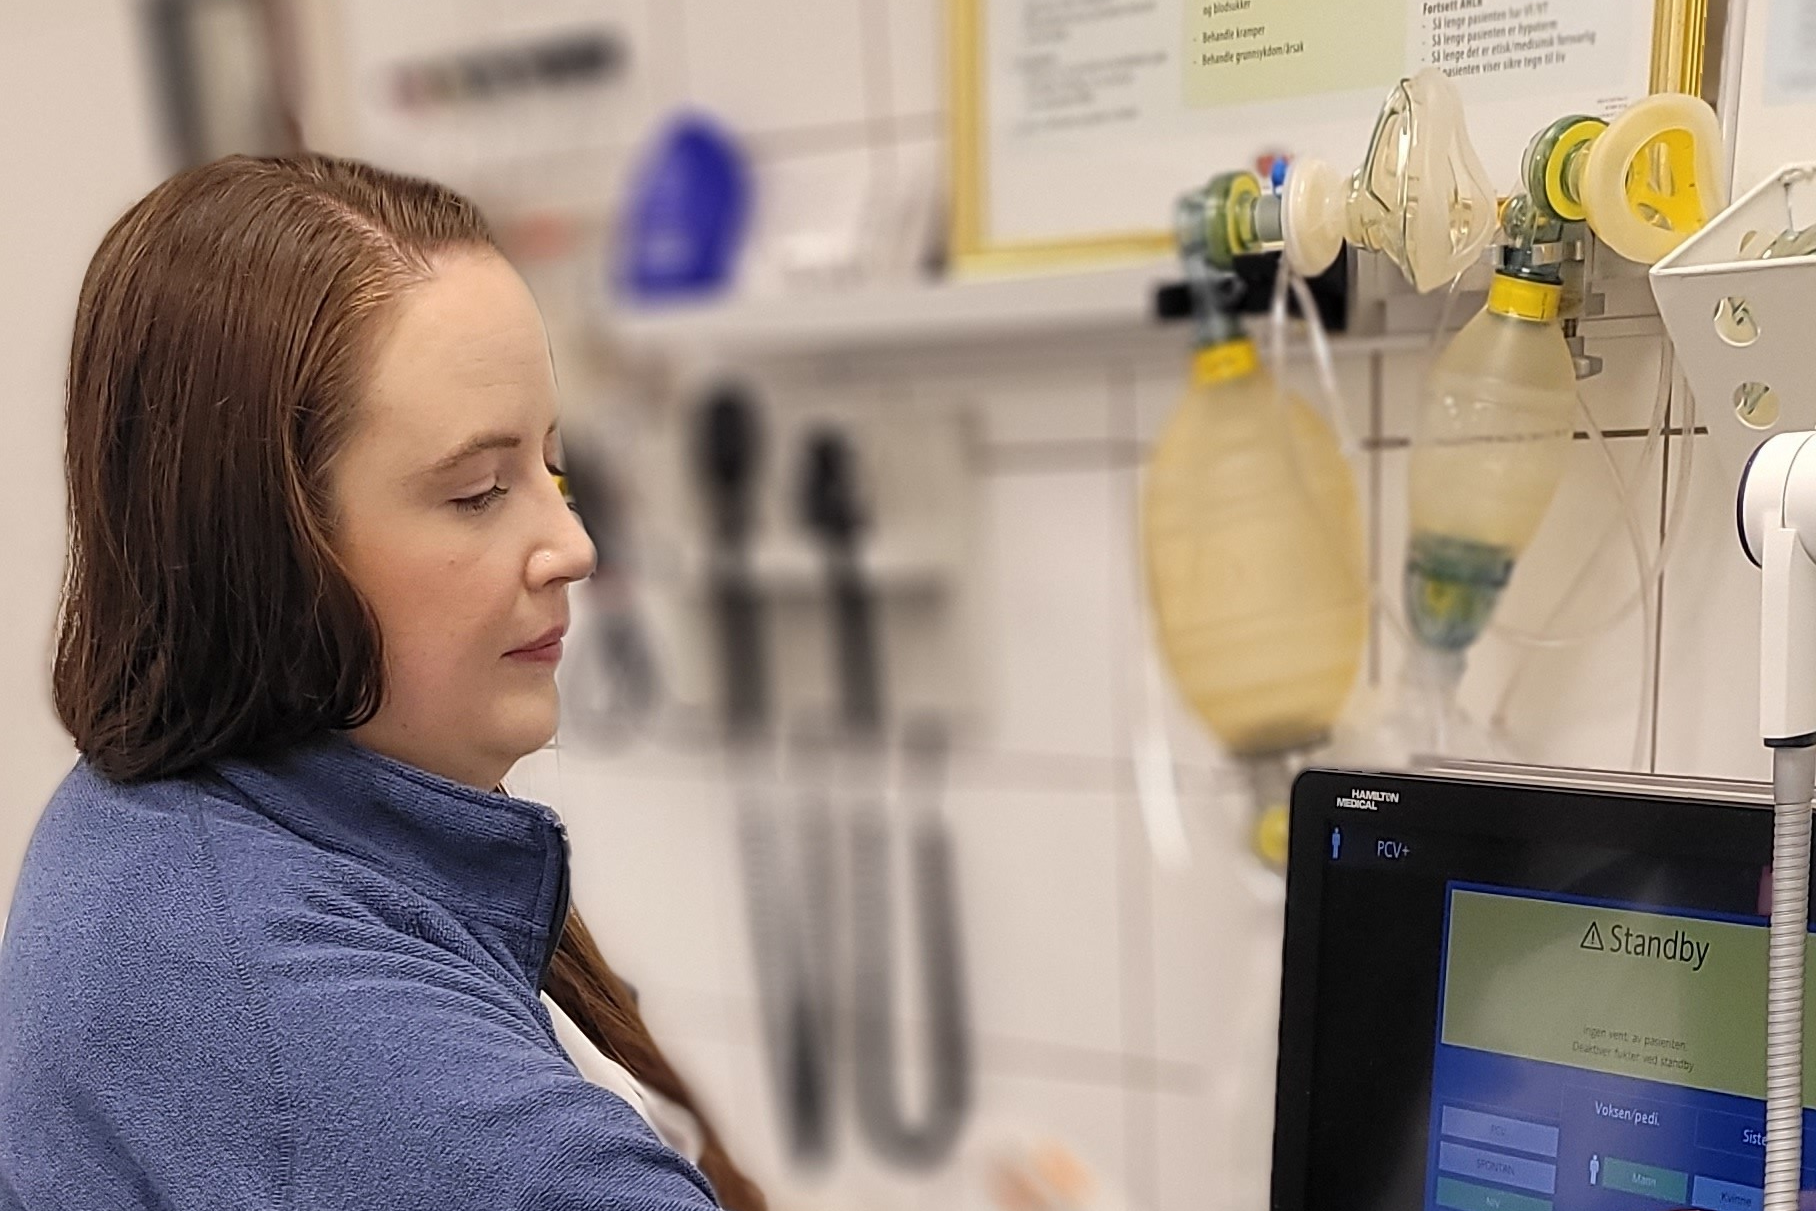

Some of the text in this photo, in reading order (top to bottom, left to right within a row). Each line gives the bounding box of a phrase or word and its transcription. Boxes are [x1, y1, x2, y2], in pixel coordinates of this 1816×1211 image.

[1423, 0, 1458, 16] Fortsett
[1432, 17, 1442, 31] Så
[1443, 15, 1466, 30] lenge
[1467, 10, 1507, 28] pasienten
[1202, 26, 1265, 44] Behandle kramper
[1432, 33, 1442, 48] Så
[1443, 32, 1466, 47] lenge
[1467, 26, 1507, 45] pasienten
[1507, 26, 1517, 37] er
[1202, 50, 1234, 66] Behandle
[1431, 50, 1441, 64] Så
[1443, 48, 1465, 64] lenge
[1466, 46, 1480, 59] det
[1481, 46, 1490, 57] er
[1483, 61, 1502, 74] viser
[1503, 57, 1522, 71] sikre
[1523, 54, 1543, 70] tegn
[1336, 797, 1378, 811] MEDICAL
[1351, 788, 1400, 803] HAMILTON
[1377, 840, 1410, 859] PCV+
[1609, 923, 1711, 972] Standby
[1660, 1055, 1695, 1074] standby
[1594, 1100, 1661, 1127] Voksen/pedi.
[1632, 1172, 1657, 1189] Mann
